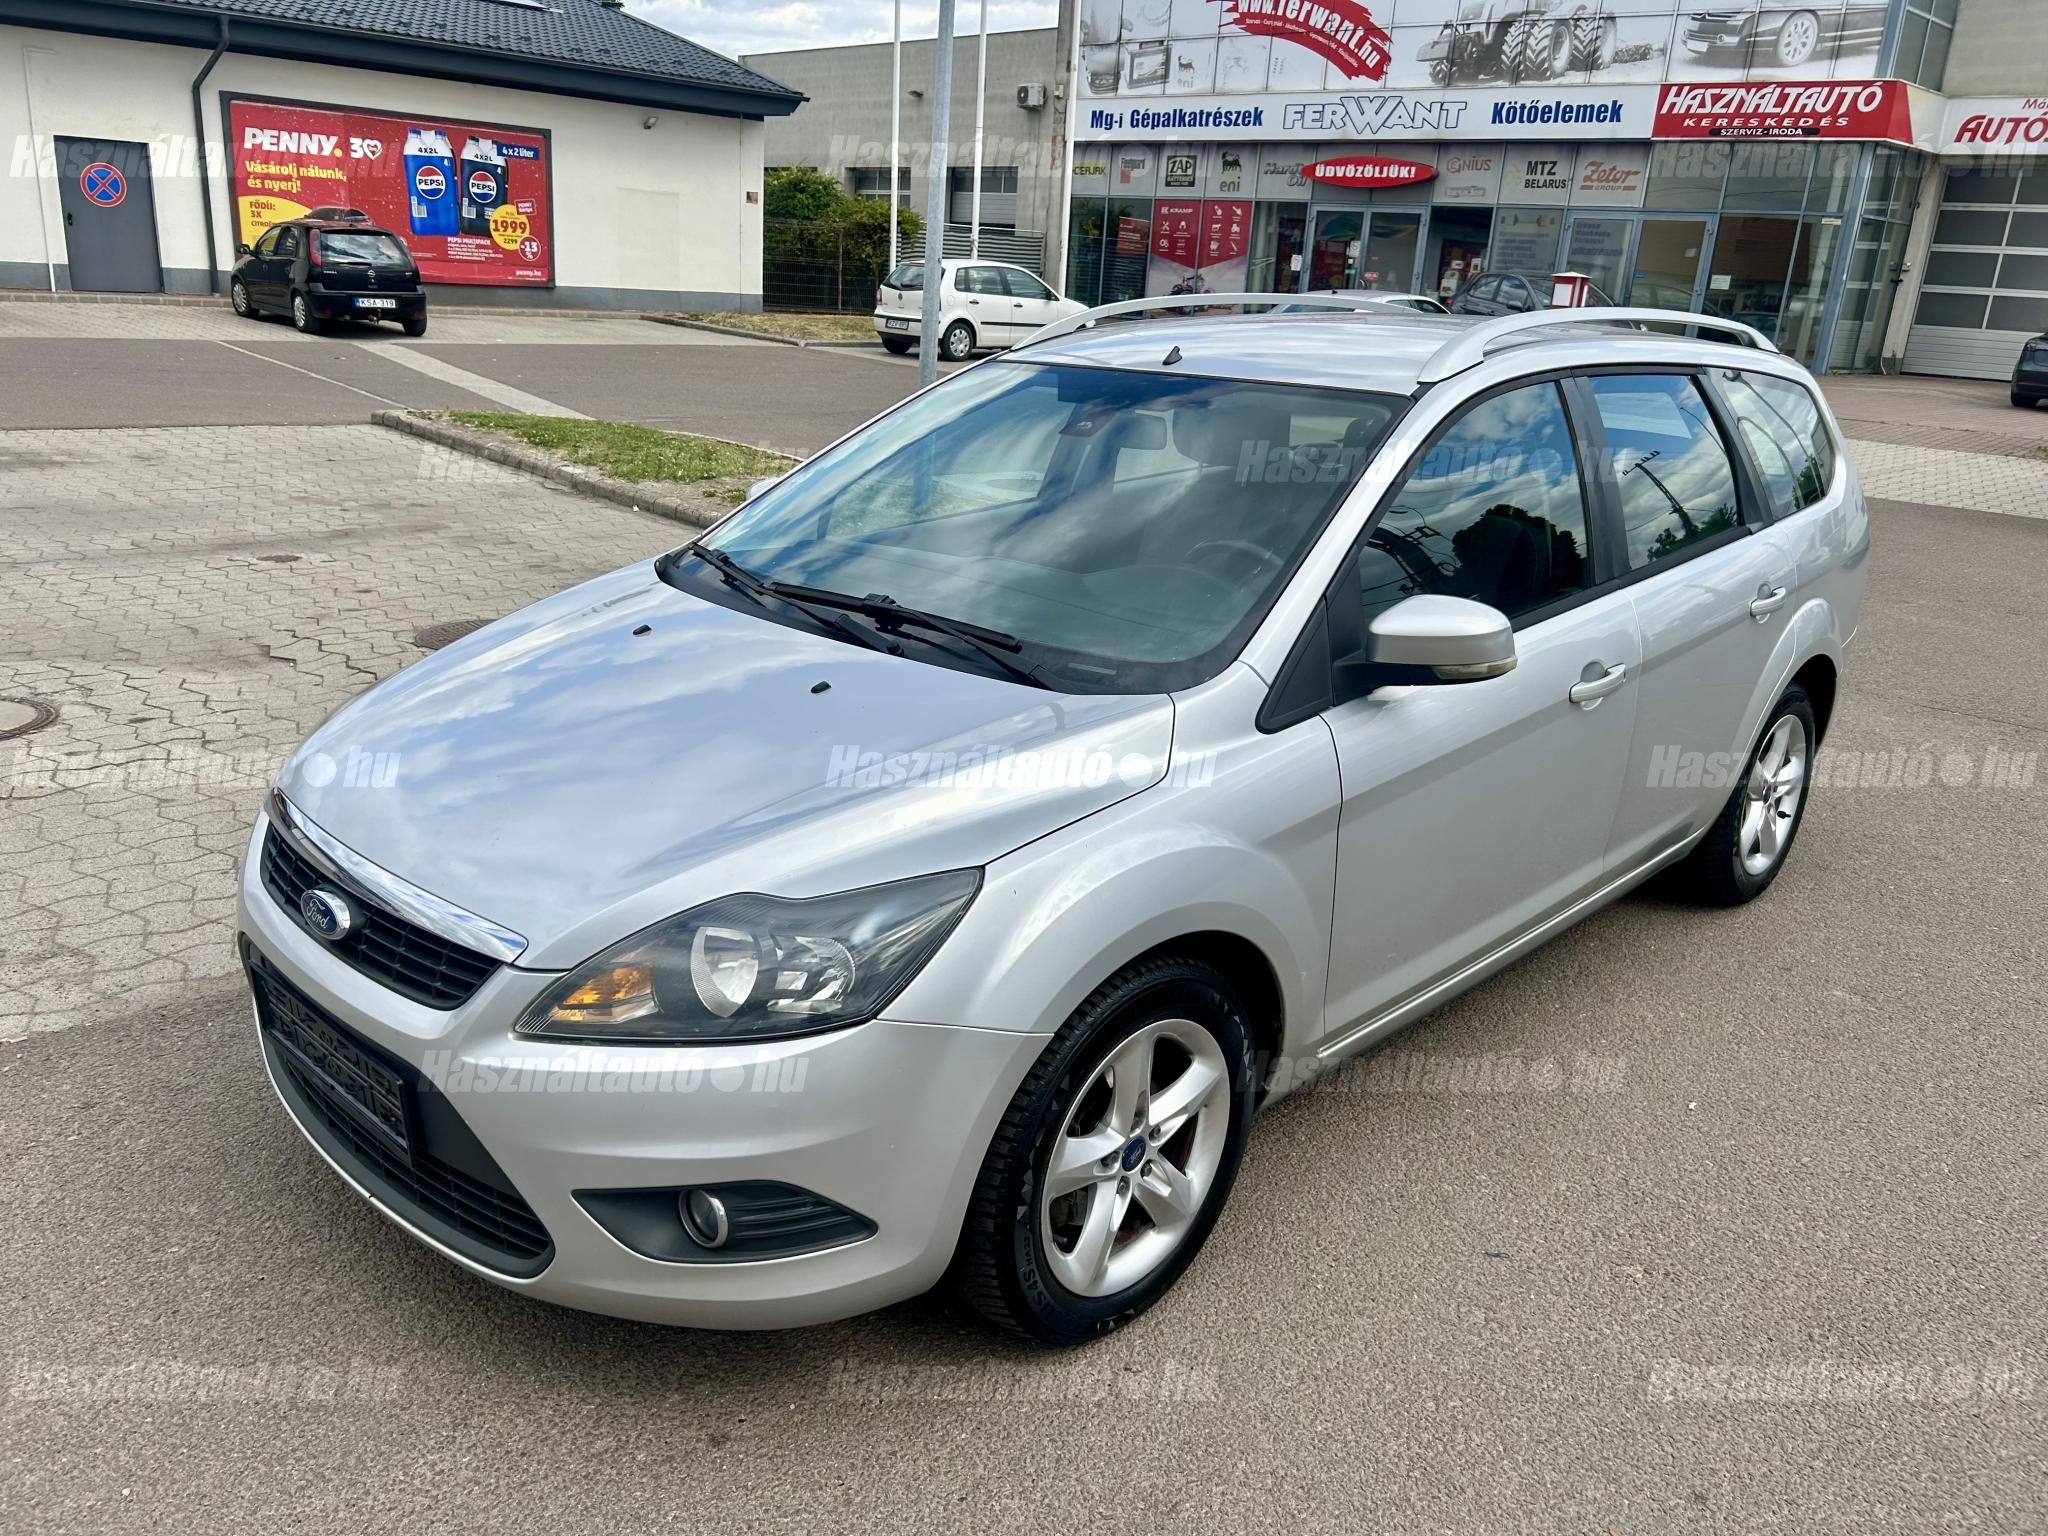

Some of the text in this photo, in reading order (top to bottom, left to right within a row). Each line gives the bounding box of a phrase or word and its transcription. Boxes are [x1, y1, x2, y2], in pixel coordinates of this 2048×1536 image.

[1660, 82, 1884, 116] HASZNÁLTAUTÓ
[1090, 107, 1264, 131] Mg-i Gépalkatrészek
[1282, 96, 1468, 135] FERWANT
[1490, 100, 1624, 125] Kötőelemek
[1683, 115, 1850, 127] KERESKEDÉS
[1953, 111, 2048, 146] AUTÓ
[245, 160, 347, 182] Vásárolj nálunk,
[1170, 159, 1192, 173] ZAP
[1314, 164, 1416, 178] ÜDVÖZÖLJÜK!
[1526, 160, 1558, 176] MTZ
[1582, 160, 1641, 184] Zetor
[246, 177, 301, 193] és nyerj!
[418, 179, 443, 187] PEPSI
[471, 182, 495, 192] PEPSI
[1219, 179, 1241, 193] eni
[1524, 178, 1567, 190] BELARUS
[250, 210, 262, 218] 3X
[492, 220, 527, 234] 1999
[306, 899, 329, 930] Ford
